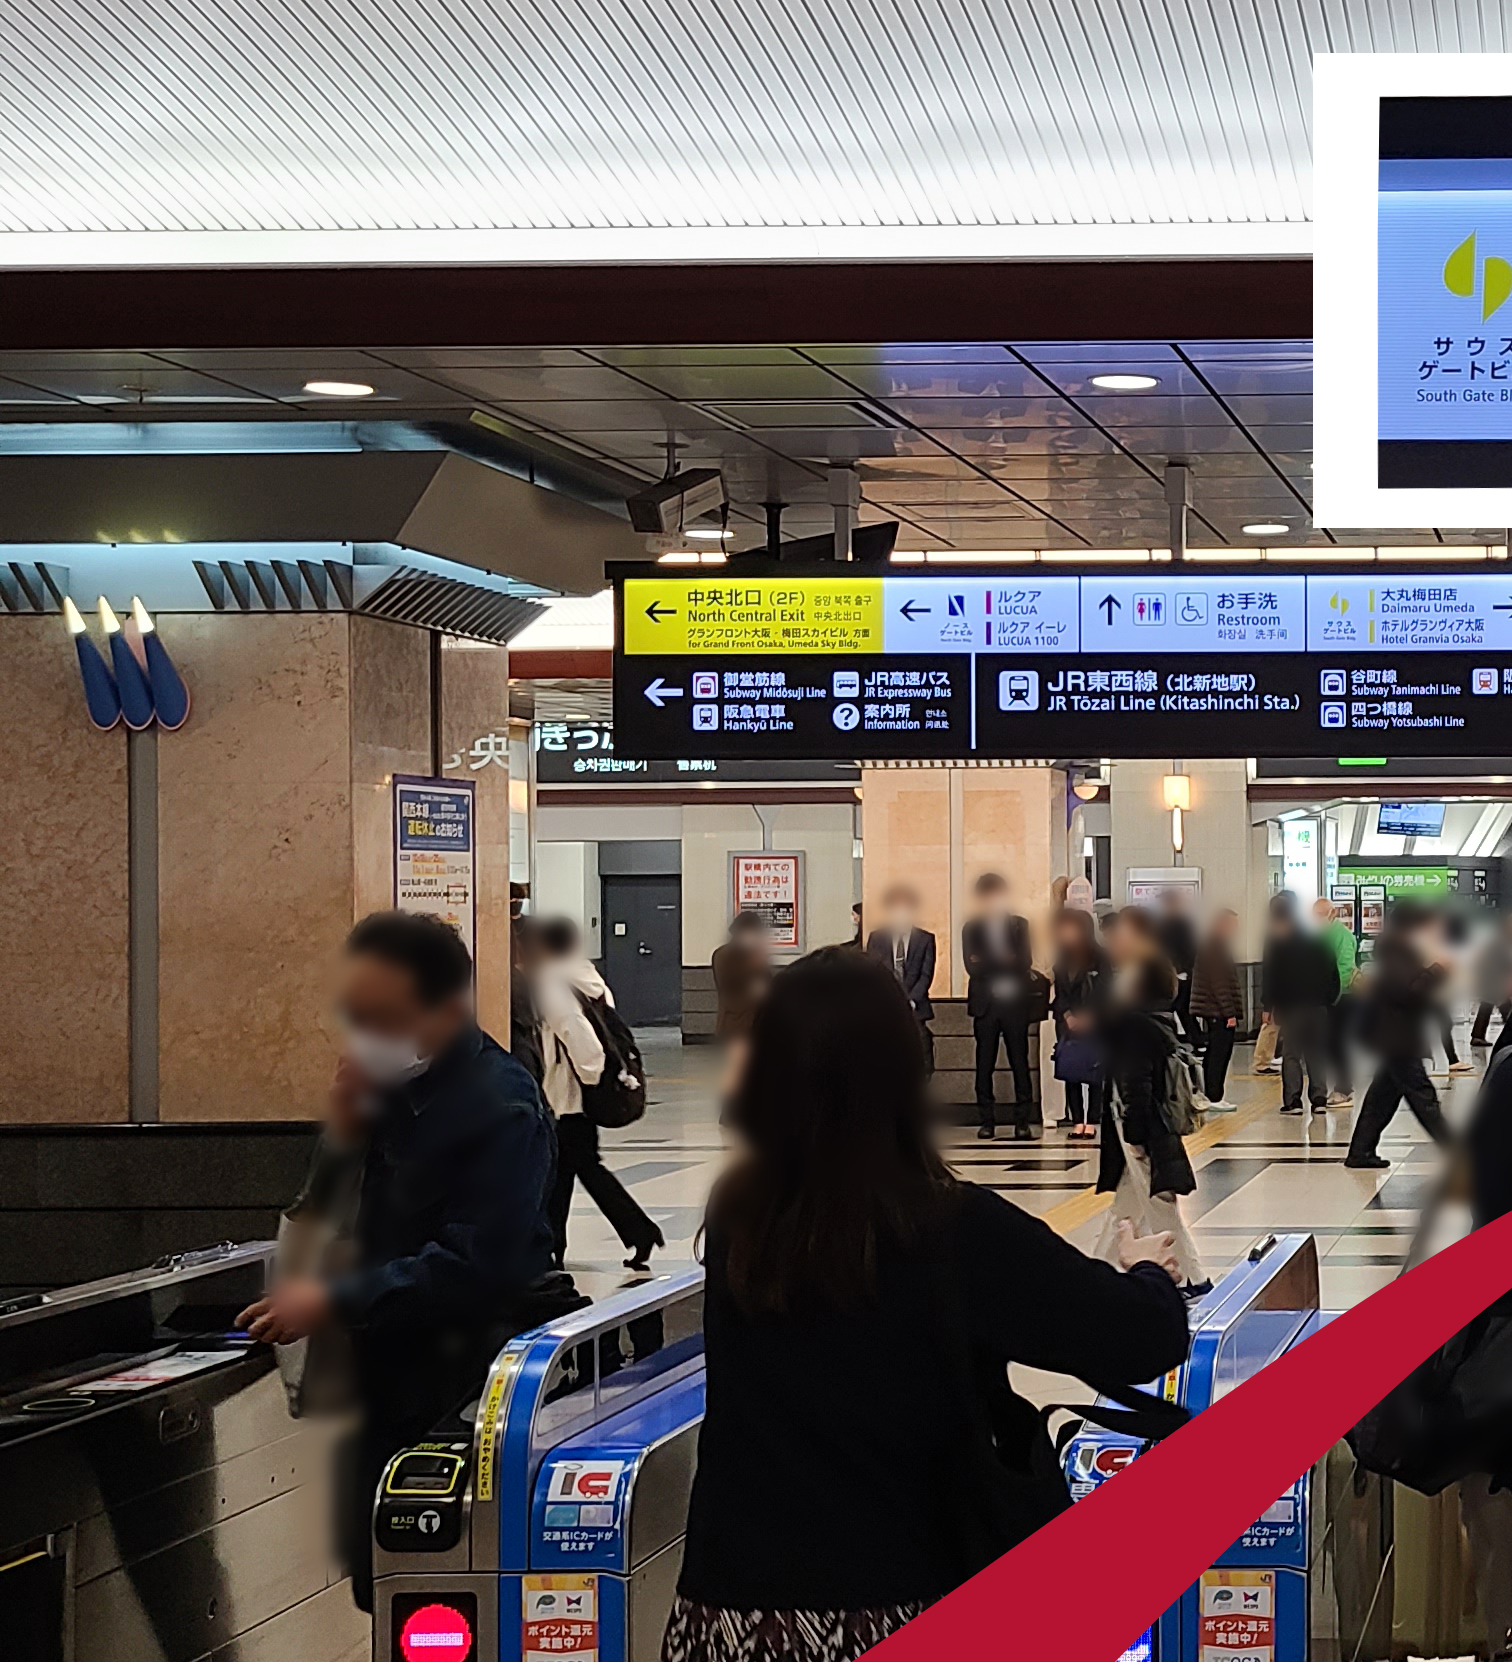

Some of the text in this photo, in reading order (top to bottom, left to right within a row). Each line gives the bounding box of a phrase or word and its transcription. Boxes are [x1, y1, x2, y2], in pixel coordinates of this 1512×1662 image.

[998, 590, 1042, 603] ルクア
[1217, 592, 1278, 611] お手洗
[1381, 588, 1458, 602] 大丸梅田店
[998, 605, 1038, 616] LUCUA
[1381, 602, 1475, 613] Daimaru Umeda
[687, 608, 806, 622] North Central Exit
[1217, 613, 1281, 626] Restroom
[998, 621, 1031, 634] ルクア
[1381, 618, 1485, 632] ホテルグランヴィア大阪
[688, 640, 701, 648] for
[703, 640, 730, 648] Grand
[732, 640, 755, 648] Front
[788, 640, 819, 648] Umeda
[821, 640, 836, 649] Sky
[998, 636, 1059, 646] LUCUA 1100
[1381, 633, 1483, 644] Hotel Granvia Osaka
[723, 671, 786, 687] 御堂筋線
[864, 671, 950, 686] JR高速バス
[1351, 669, 1397, 684] 谷町線
[723, 686, 761, 700] Subway
[806, 686, 827, 698] Line
[864, 687, 952, 700] JR Expressway Bus
[1351, 684, 1461, 697] Subway Tanimachi Line
[1047, 693, 1300, 712] JR Tōzai Line (Kitashinchi Sta.)
[1351, 701, 1413, 716] 四つ橋線
[723, 704, 785, 719] 阪急電車
[864, 704, 911, 718] 案内所
[723, 719, 794, 732] Hankyū Line
[864, 719, 920, 731] Information
[1351, 716, 1465, 729] Subway Yotsubashi Line
[542, 1530, 614, 1541] 交通系ICカードが
[560, 1541, 595, 1552] 使えます
